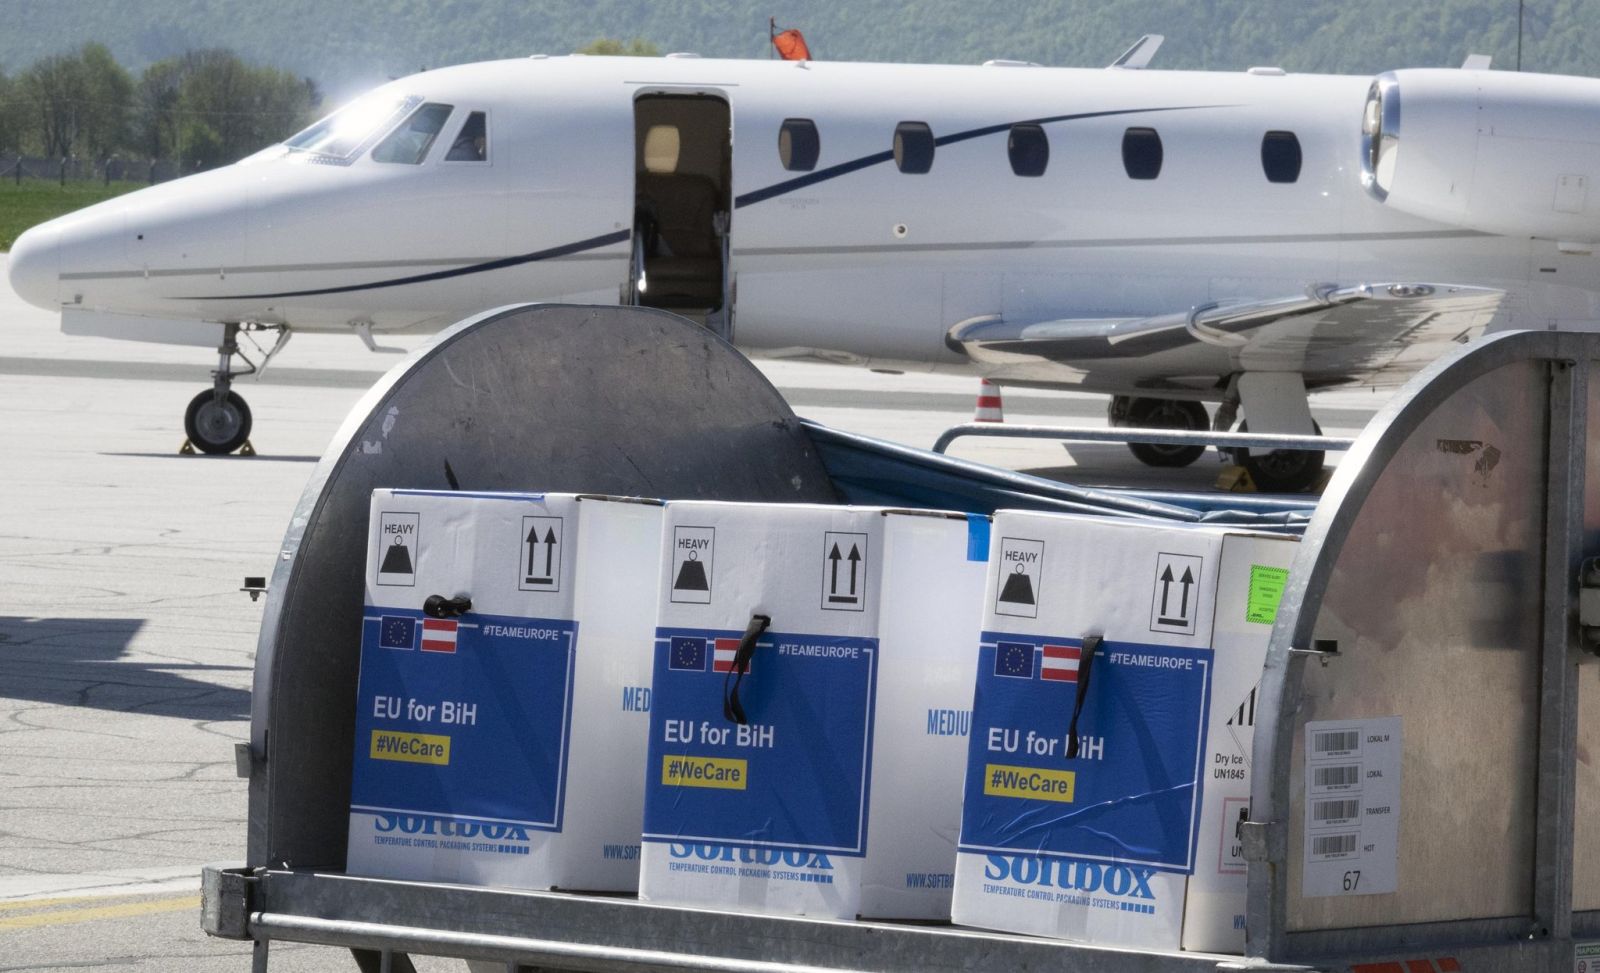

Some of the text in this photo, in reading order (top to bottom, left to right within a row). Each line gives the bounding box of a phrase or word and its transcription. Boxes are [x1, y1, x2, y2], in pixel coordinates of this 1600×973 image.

[384, 524, 414, 534] HEAVY
[678, 538, 709, 550] HEAVY
[1004, 550, 1038, 563] HEAVY
[483, 625, 559, 640] #TEAMEUROPE
[779, 643, 858, 659] #TEAMEUROPE
[1109, 652, 1193, 670] #TEAMEUROPE
[373, 695, 477, 726] EU for BiH
[927, 709, 973, 736] MEDIU
[664, 719, 774, 748] EU for BiH
[987, 727, 1020, 752] EU
[1025, 730, 1059, 756] for
[376, 735, 444, 757] #WeCare
[1215, 753, 1244, 766] Dry Ice
[668, 760, 741, 782] #WeCare
[1214, 768, 1245, 779] UN1845
[991, 769, 1068, 794] #WeCare
[374, 835, 498, 853] TEMPERATURE CONTROL PACKAGING SYSTEMS
[669, 862, 800, 881] TEMPERATURE CONTROL PACKAGING SYSTEMS
[1343, 870, 1361, 891] 67
[983, 884, 1121, 910] TEMPERATURE CONTROL PACKAGING SYSTEMS
